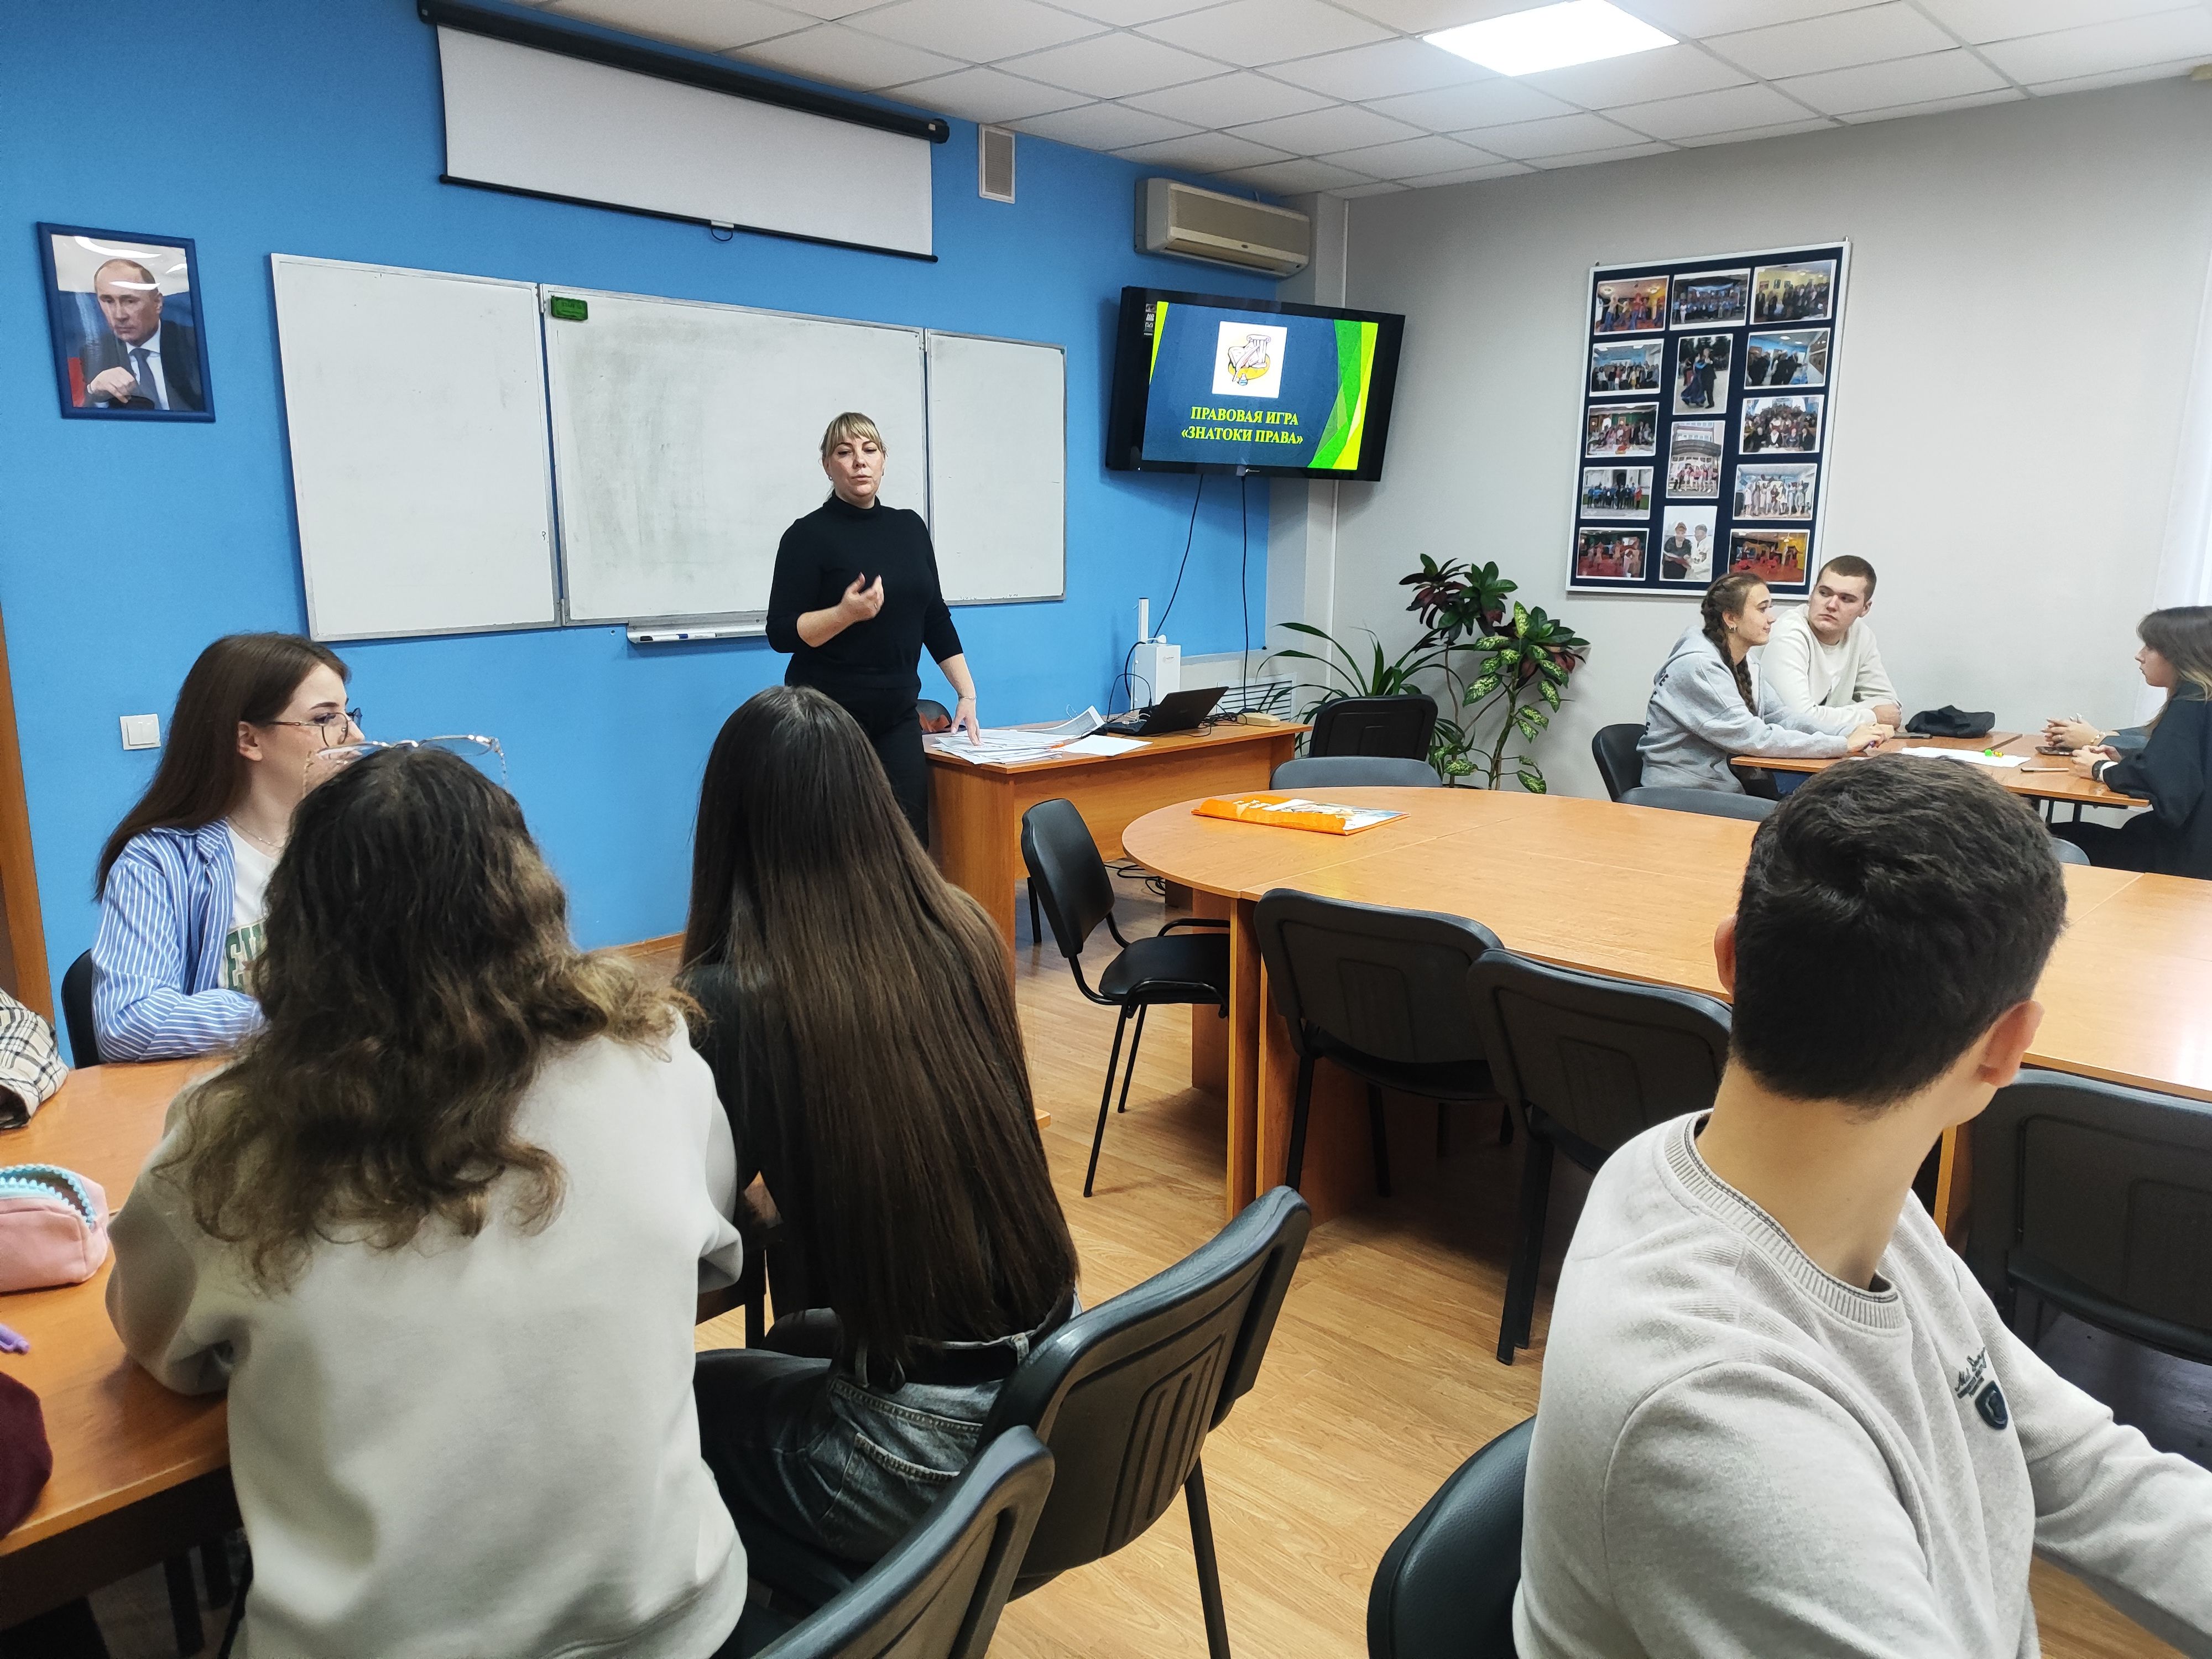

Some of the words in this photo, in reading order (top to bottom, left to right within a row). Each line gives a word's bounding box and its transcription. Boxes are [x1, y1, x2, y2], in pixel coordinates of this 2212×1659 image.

[1190, 406, 1264, 424] ПРАВОВАЯ
[1265, 411, 1299, 426] ИГРА
[1181, 426, 1253, 442] «ЗНАТОКИ
[1254, 430, 1304, 445] ПРАВА»
